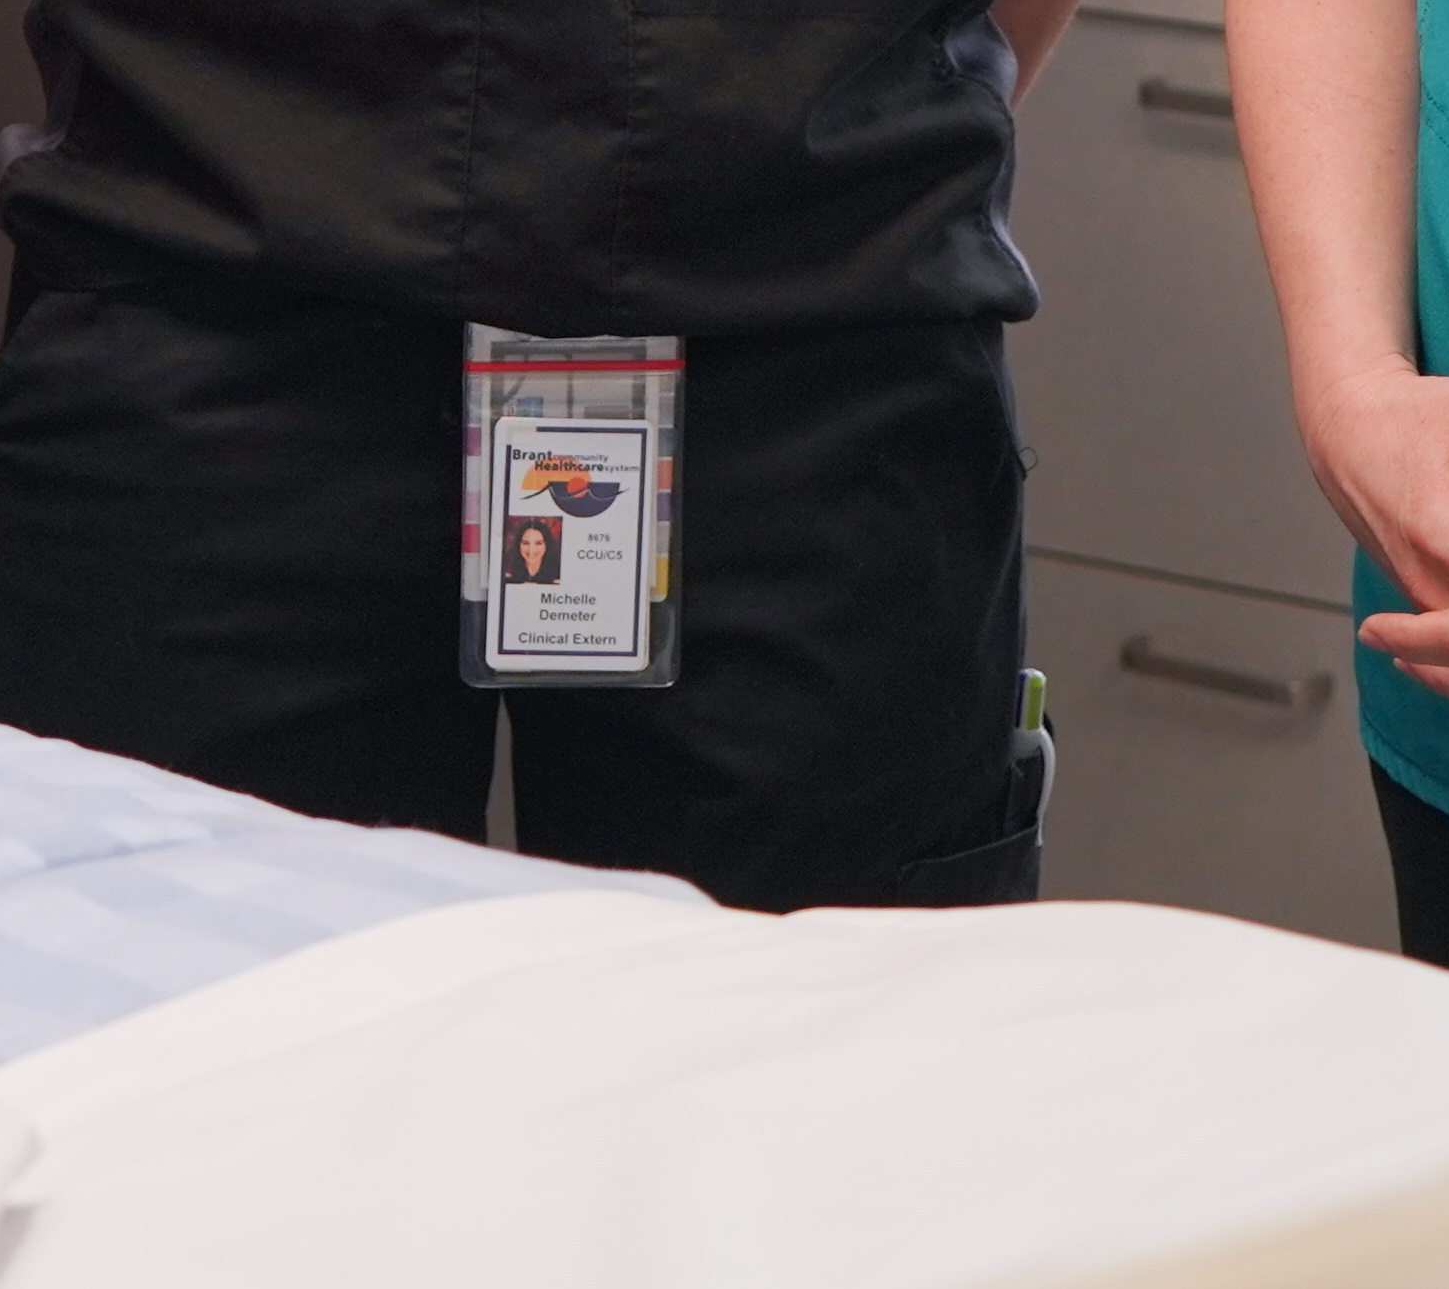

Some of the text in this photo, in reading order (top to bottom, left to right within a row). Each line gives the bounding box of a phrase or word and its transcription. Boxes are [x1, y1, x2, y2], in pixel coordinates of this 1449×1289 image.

[540, 593, 597, 605] Michelle
[539, 609, 597, 622] Demeter
[518, 631, 617, 646] Clinical Extern
